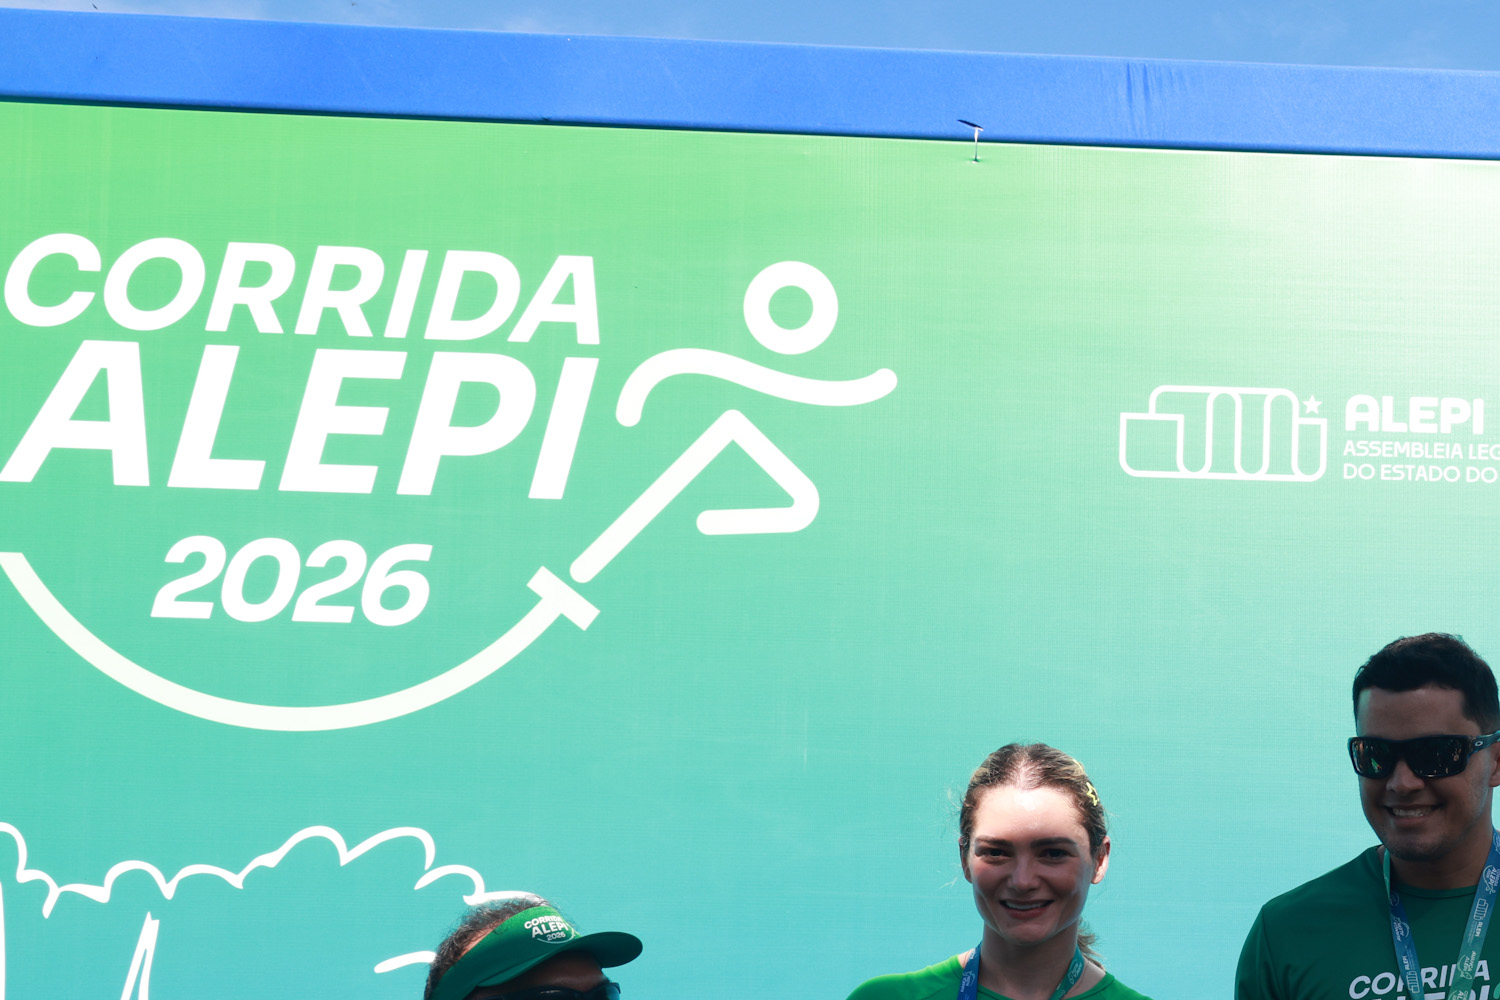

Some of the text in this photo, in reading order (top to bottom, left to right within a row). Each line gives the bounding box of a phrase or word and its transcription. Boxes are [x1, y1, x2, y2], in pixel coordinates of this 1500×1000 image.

[4, 232, 600, 345] CORRIDA
[0, 339, 600, 500] ALEPI
[1344, 394, 1484, 434] ALEPI
[1343, 440, 1464, 460] ASSEMBLEIA
[1343, 464, 1372, 480] DO
[1380, 464, 1460, 482] ESTADO
[1466, 466, 1497, 483] DO
[150, 535, 433, 626] 2026
[1489, 867, 1497, 886] ALEPI
[524, 916, 564, 929] CORRIDA
[532, 922, 568, 938] ALEPI
[546, 931, 566, 941] 2026
[1349, 960, 1490, 1000] CORIA
